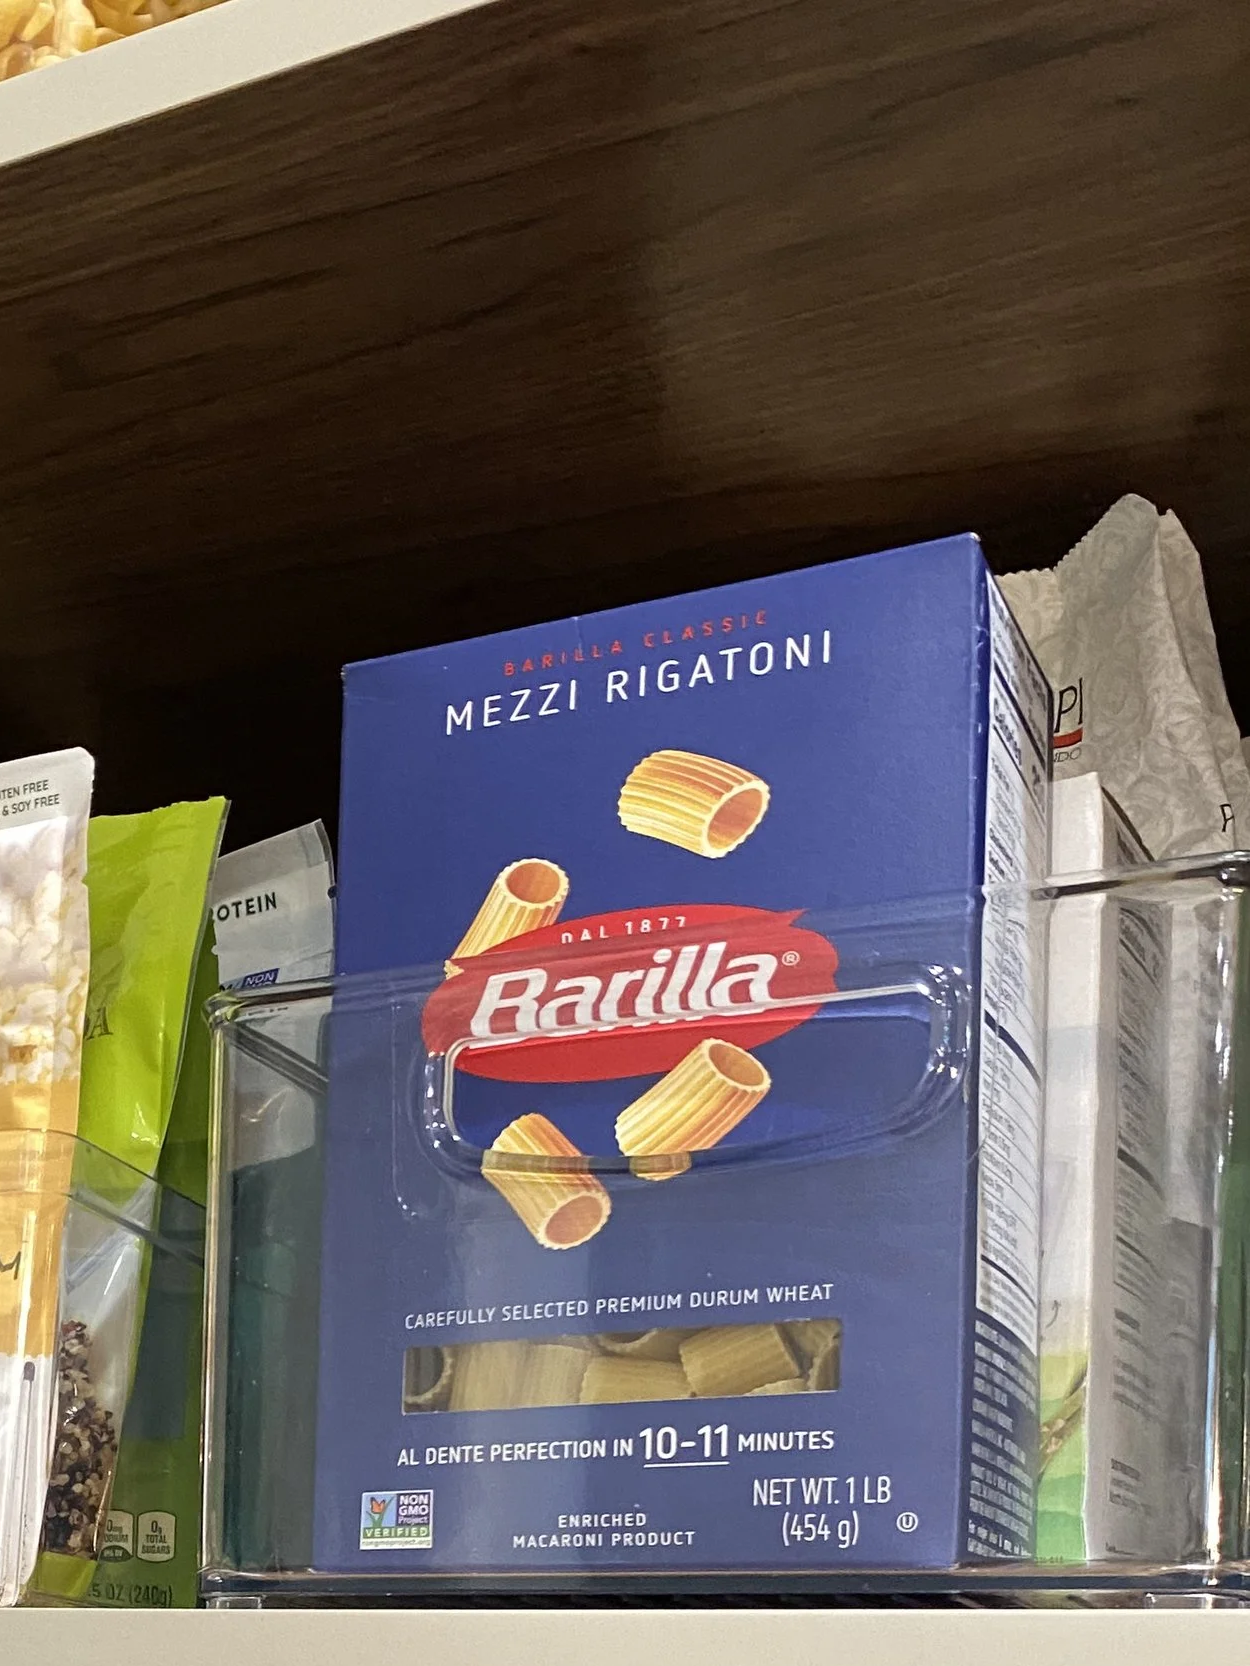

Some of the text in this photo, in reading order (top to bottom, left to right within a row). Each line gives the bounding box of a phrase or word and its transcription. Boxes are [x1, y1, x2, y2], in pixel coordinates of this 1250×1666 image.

[503, 610, 769, 677] BARILLA CLASSIC
[446, 630, 832, 735] MEZZI RIGATONI
[23, 780, 49, 795] FREE
[2, 806, 9, 816] &
[12, 800, 31, 814] SOY
[34, 794, 60, 808] FREE
[625, 916, 687, 936] 1877
[469, 941, 778, 1045] Barilla
[405, 1283, 833, 1329] CAREFULLY SELECTED PREMIUM DURUM WHEAT
[397, 1424, 835, 1467] AL DENTE PERFECTION IN 10-11 MINUTES
[399, 1495, 429, 1505] NON
[753, 1476, 891, 1505] NET WT. 1 LB
[398, 1505, 429, 1516] GMO
[558, 1513, 646, 1527] ENRICHED
[363, 1527, 429, 1538] VERIFIED
[513, 1531, 695, 1548] MACARONI PRODUCT
[781, 1510, 860, 1549] (454 g)
